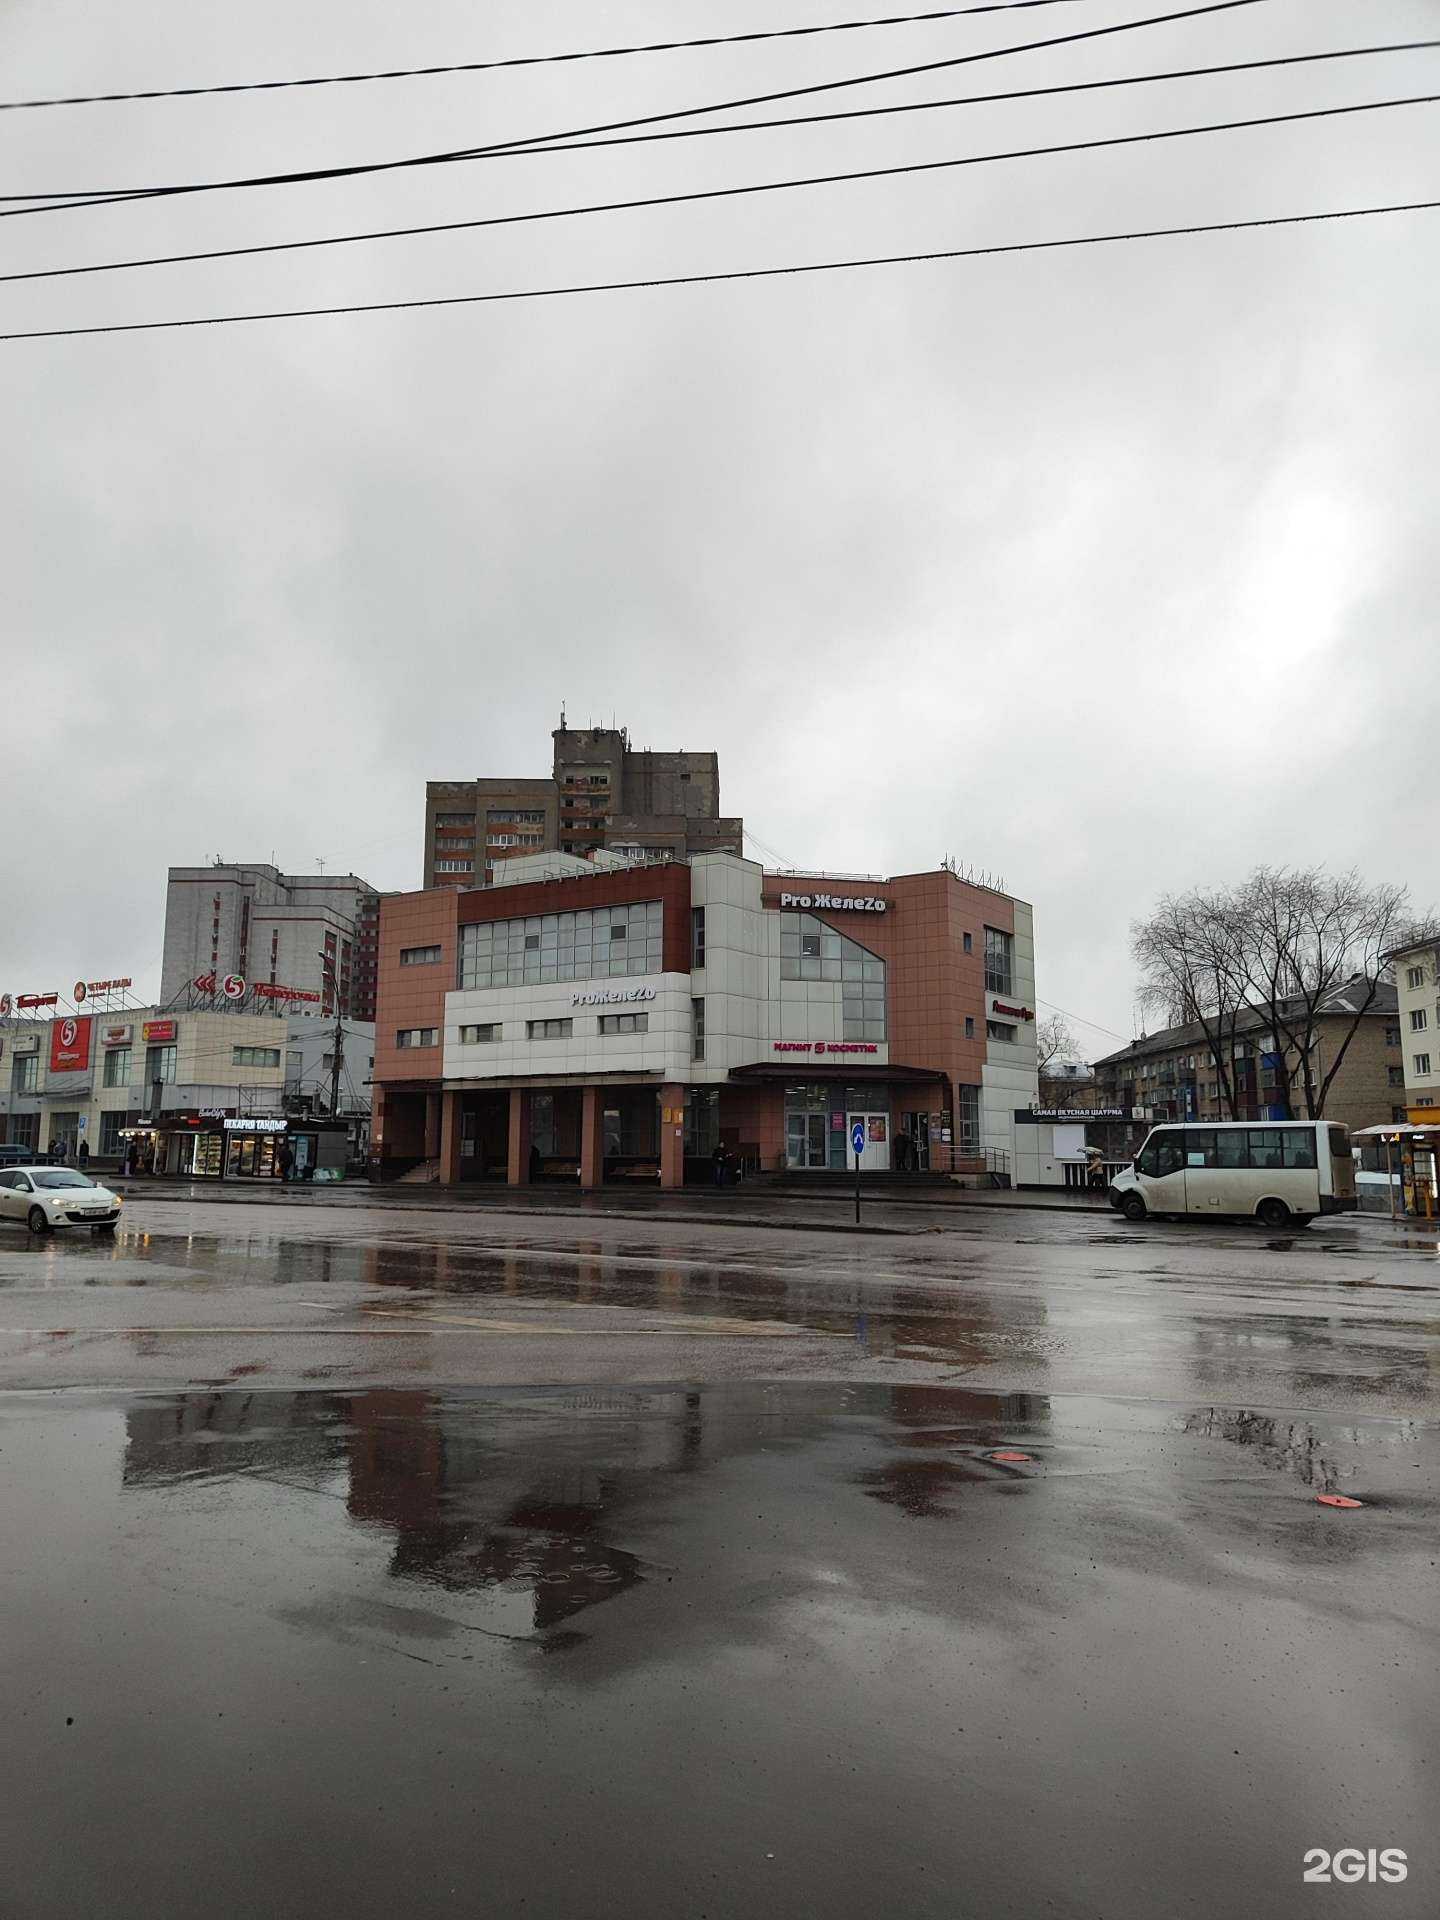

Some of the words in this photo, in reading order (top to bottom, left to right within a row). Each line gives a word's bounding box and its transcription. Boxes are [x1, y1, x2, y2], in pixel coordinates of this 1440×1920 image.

[781, 893, 811, 907] Pro
[815, 894, 886, 911] ЖелеZo
[774, 1042, 812, 1052] МАГНИТ
[223, 1119, 255, 1130] ПЕКАРНЯ
[256, 1119, 288, 1132] ТАНДЫР
